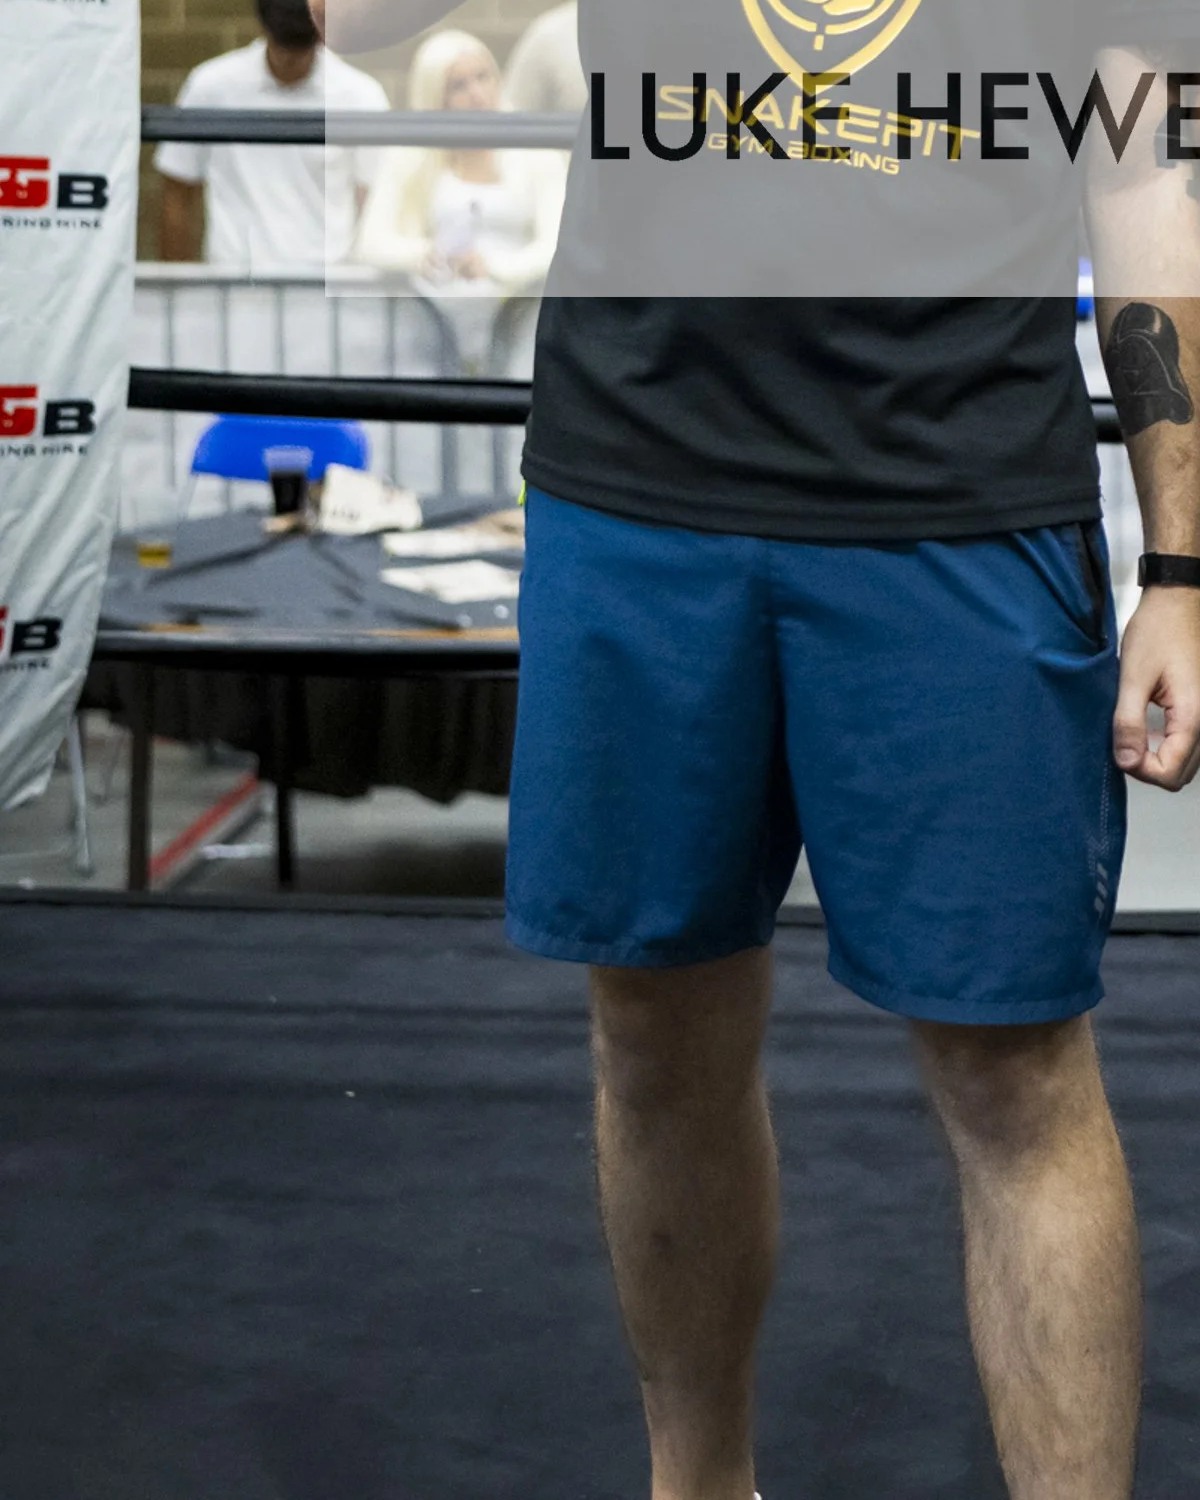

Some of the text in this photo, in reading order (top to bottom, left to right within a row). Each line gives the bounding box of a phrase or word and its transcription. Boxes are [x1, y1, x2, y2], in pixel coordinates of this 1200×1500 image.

[657, 84, 981, 162] SNAKEPIT
[706, 132, 900, 176] GYM BOXING
